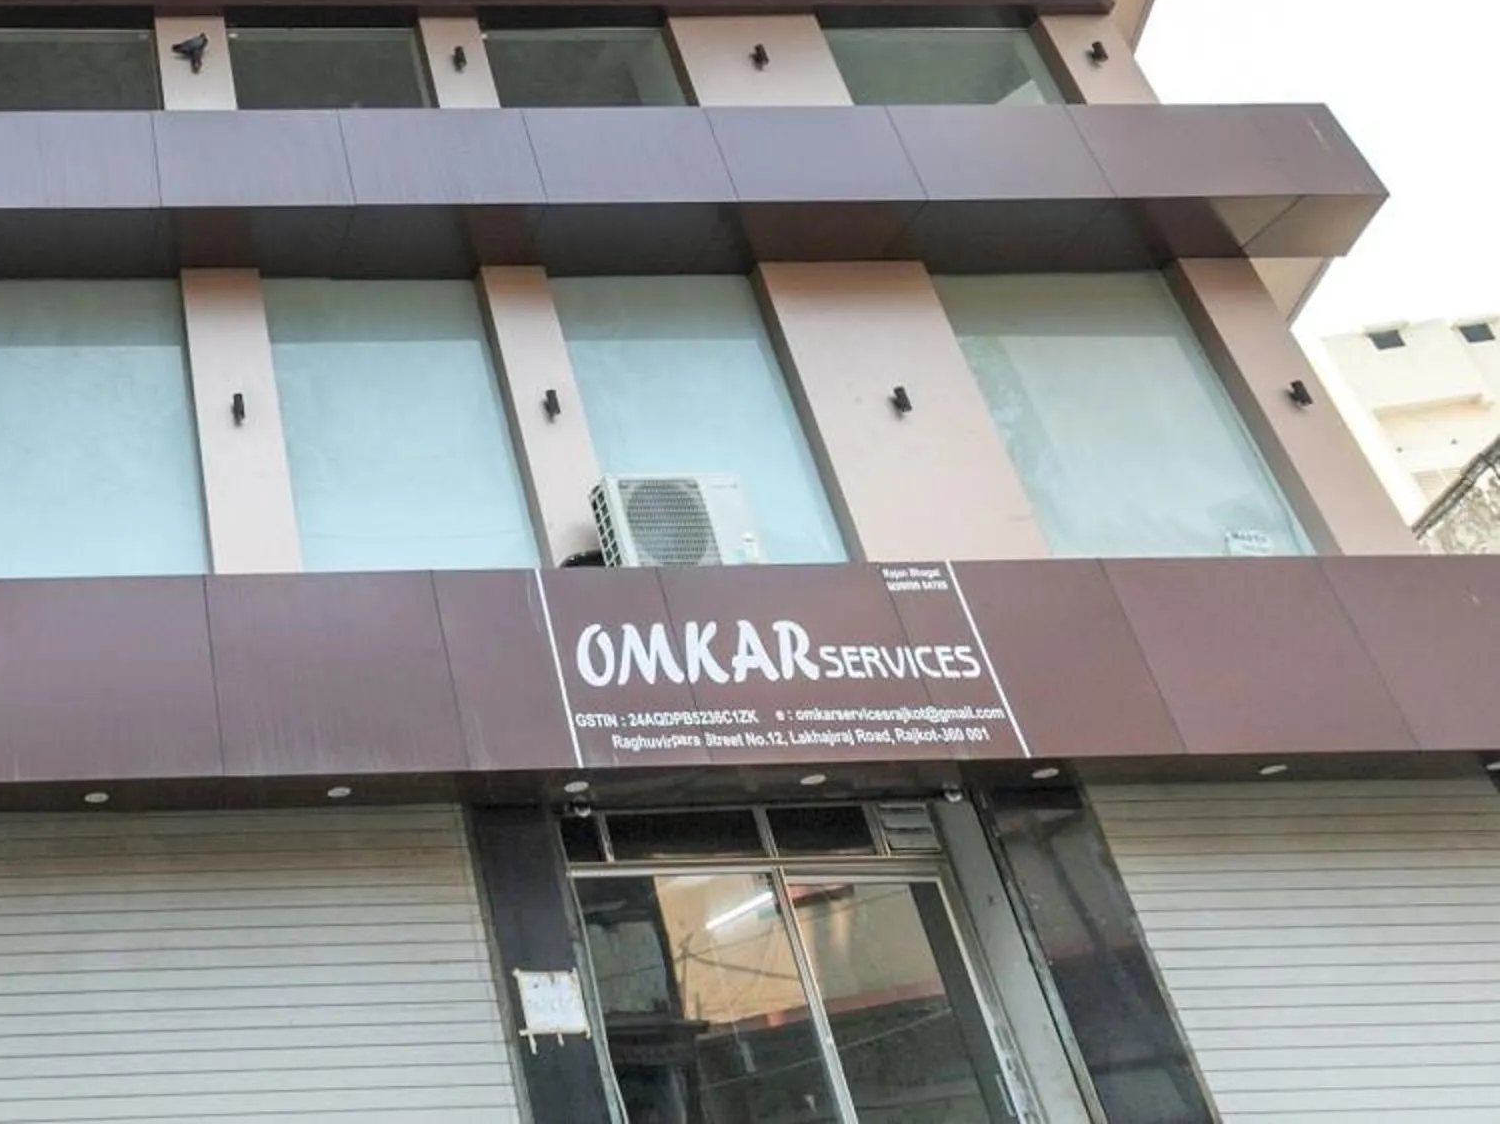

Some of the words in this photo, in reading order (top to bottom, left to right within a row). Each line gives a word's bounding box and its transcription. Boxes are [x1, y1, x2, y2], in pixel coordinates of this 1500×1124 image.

[576, 619, 820, 687] OMKAR
[819, 645, 982, 679] SERVICES
[575, 713, 617, 728] GSTIN
[703, 731, 743, 748] Street
